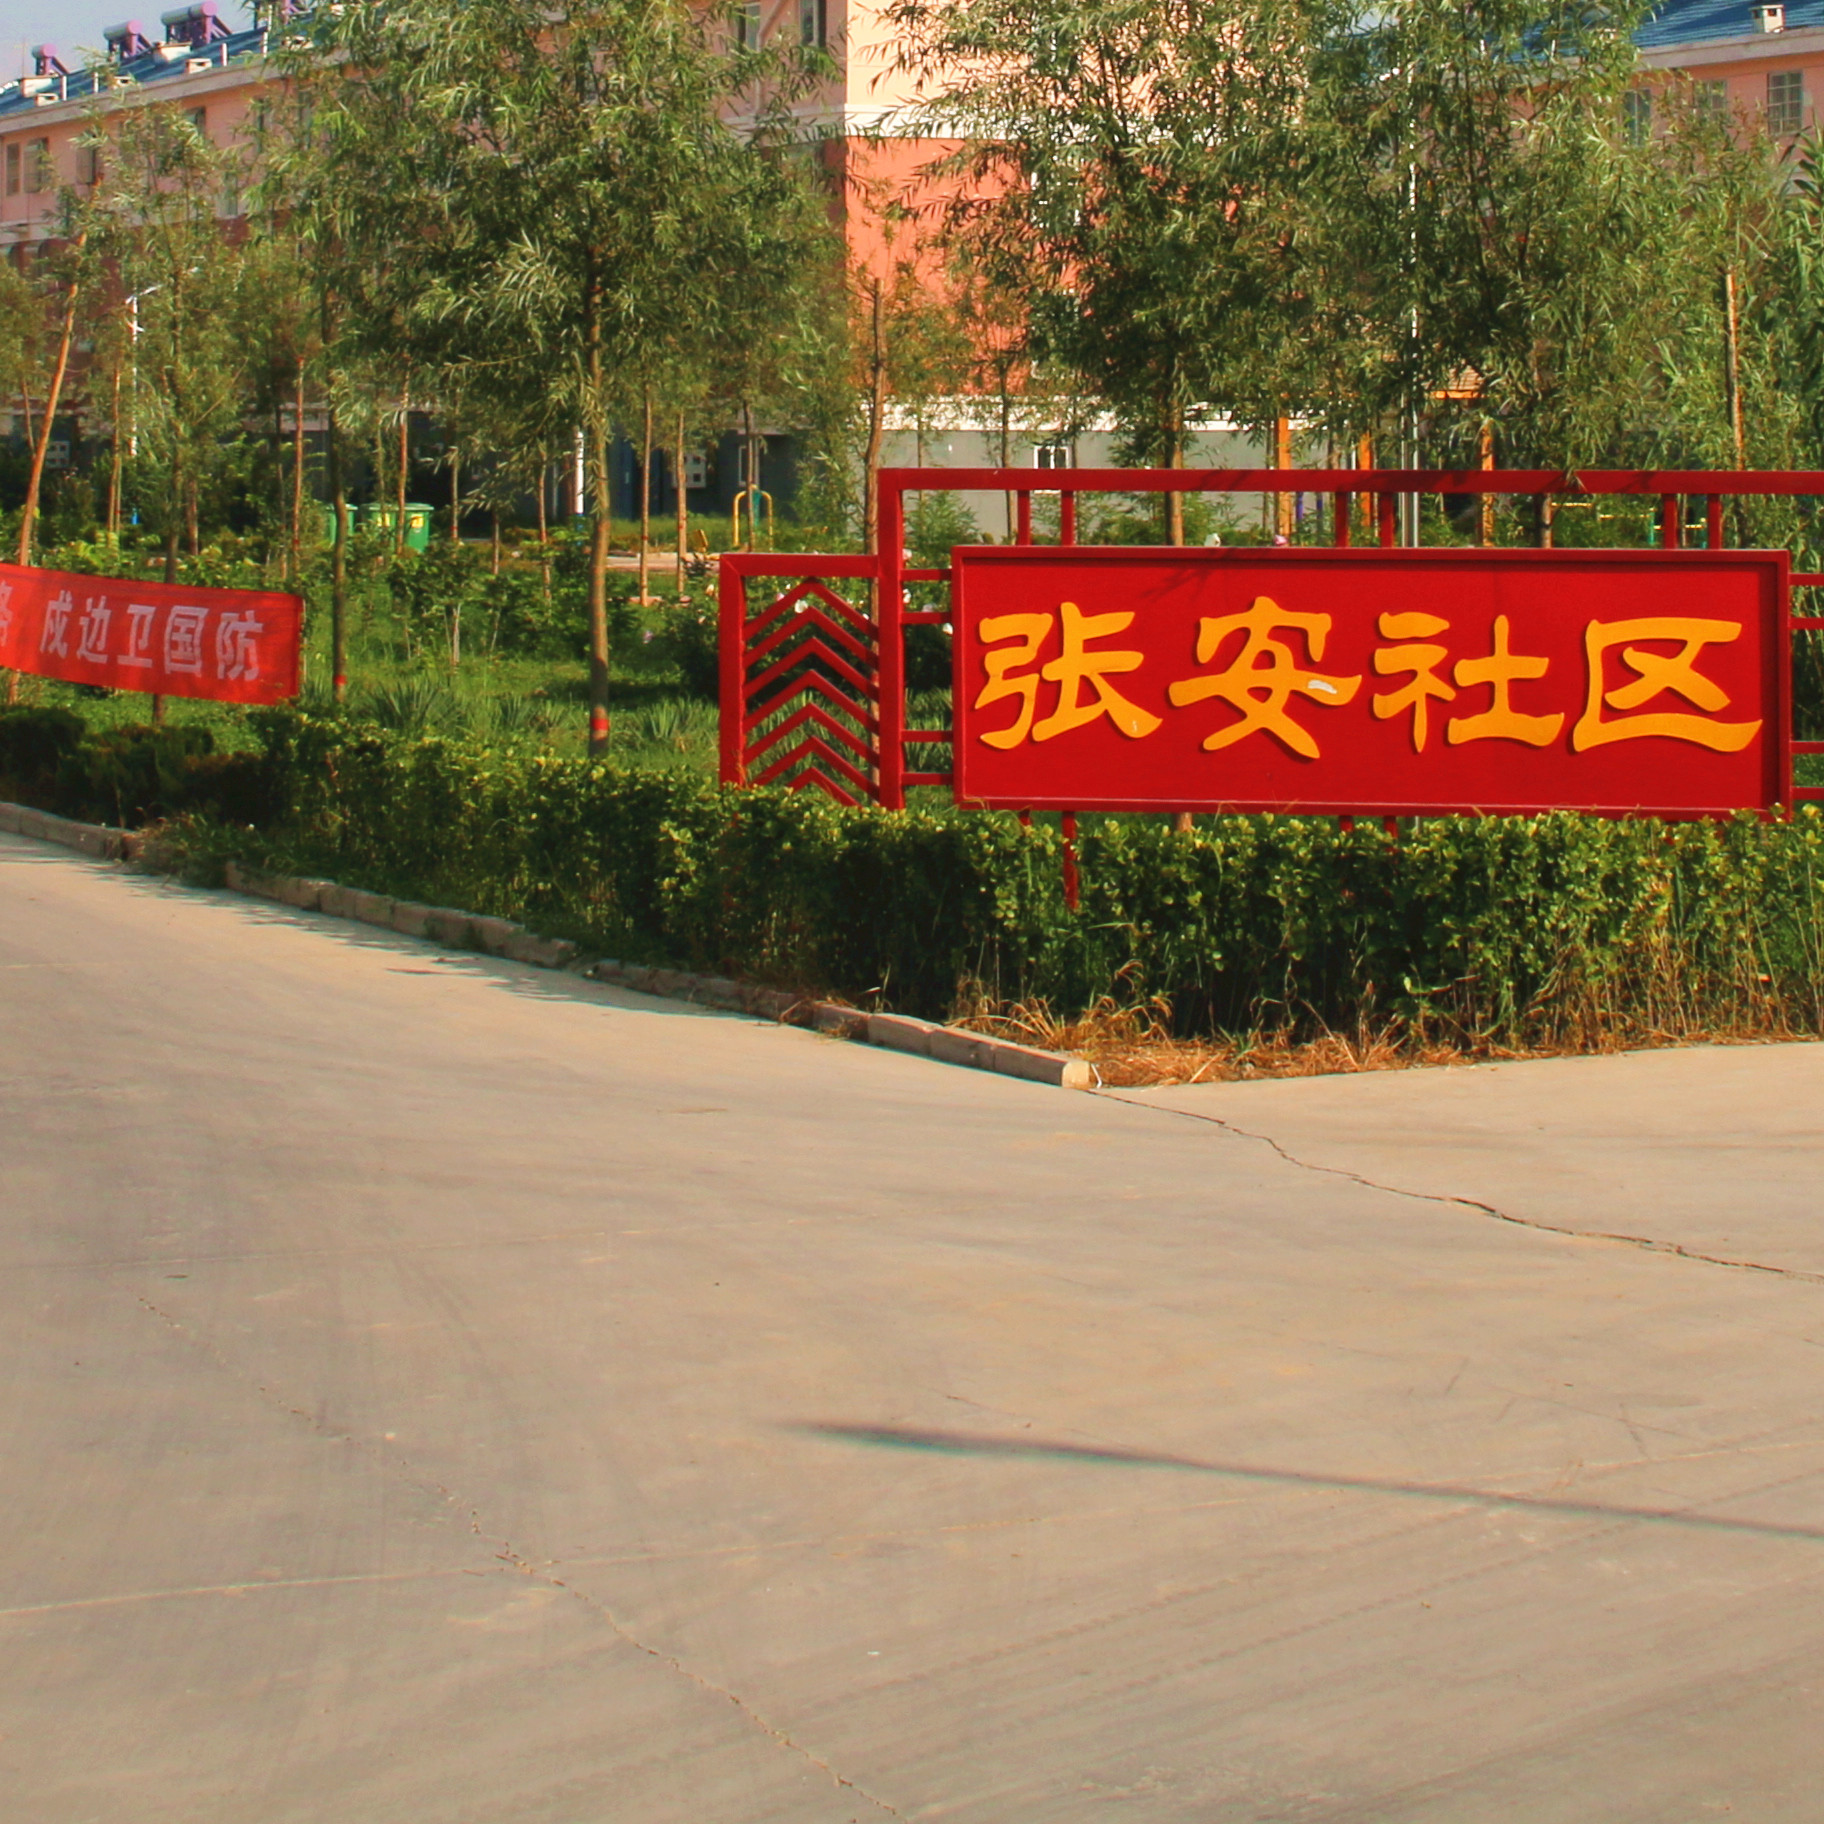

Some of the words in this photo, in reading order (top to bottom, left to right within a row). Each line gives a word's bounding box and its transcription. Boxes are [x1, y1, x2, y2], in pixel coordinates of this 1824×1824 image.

[39, 589, 264, 681] 戍边卫国防
[975, 596, 1764, 759] 张安社区
